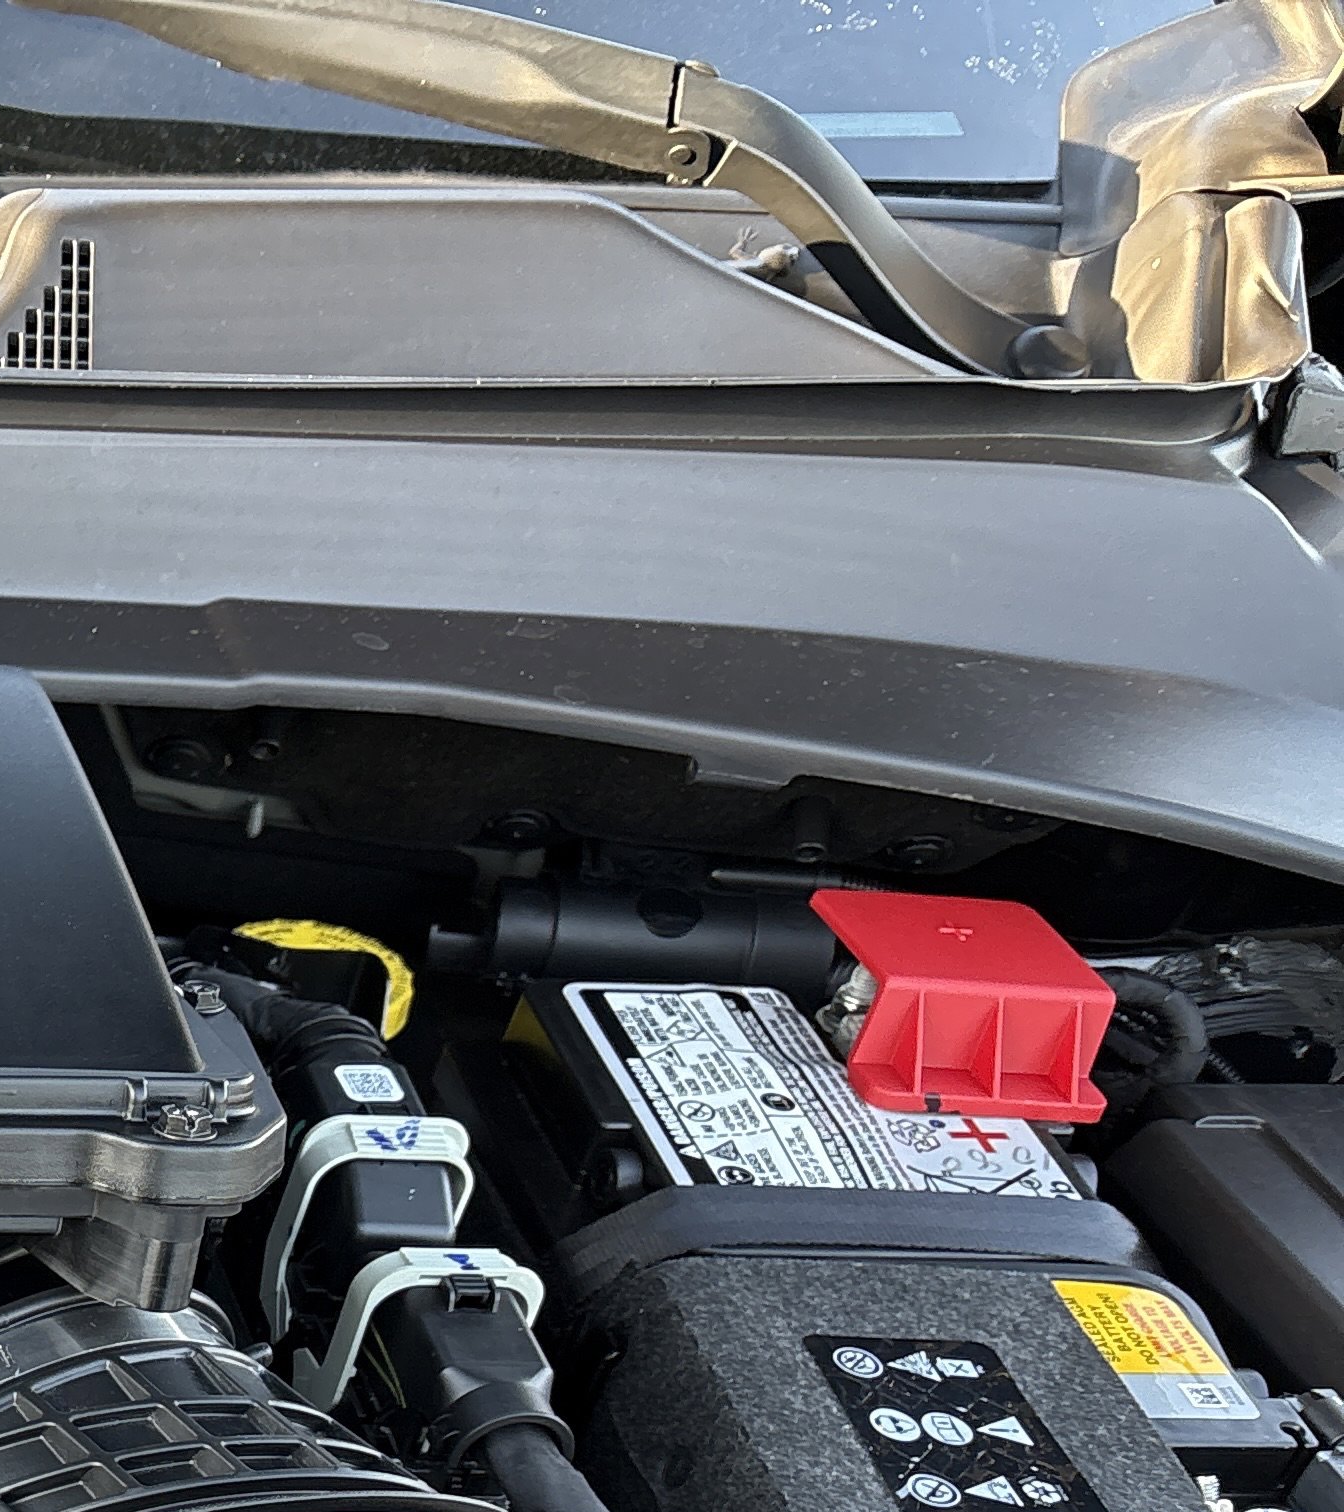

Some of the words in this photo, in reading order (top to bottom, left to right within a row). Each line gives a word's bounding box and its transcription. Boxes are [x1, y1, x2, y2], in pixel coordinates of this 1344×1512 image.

[1082, 1321, 1121, 1362] SEALED
[1088, 1305, 1132, 1352] BATTERY
[1121, 1326, 1147, 1348] NOT
[1140, 1350, 1160, 1365] DO
